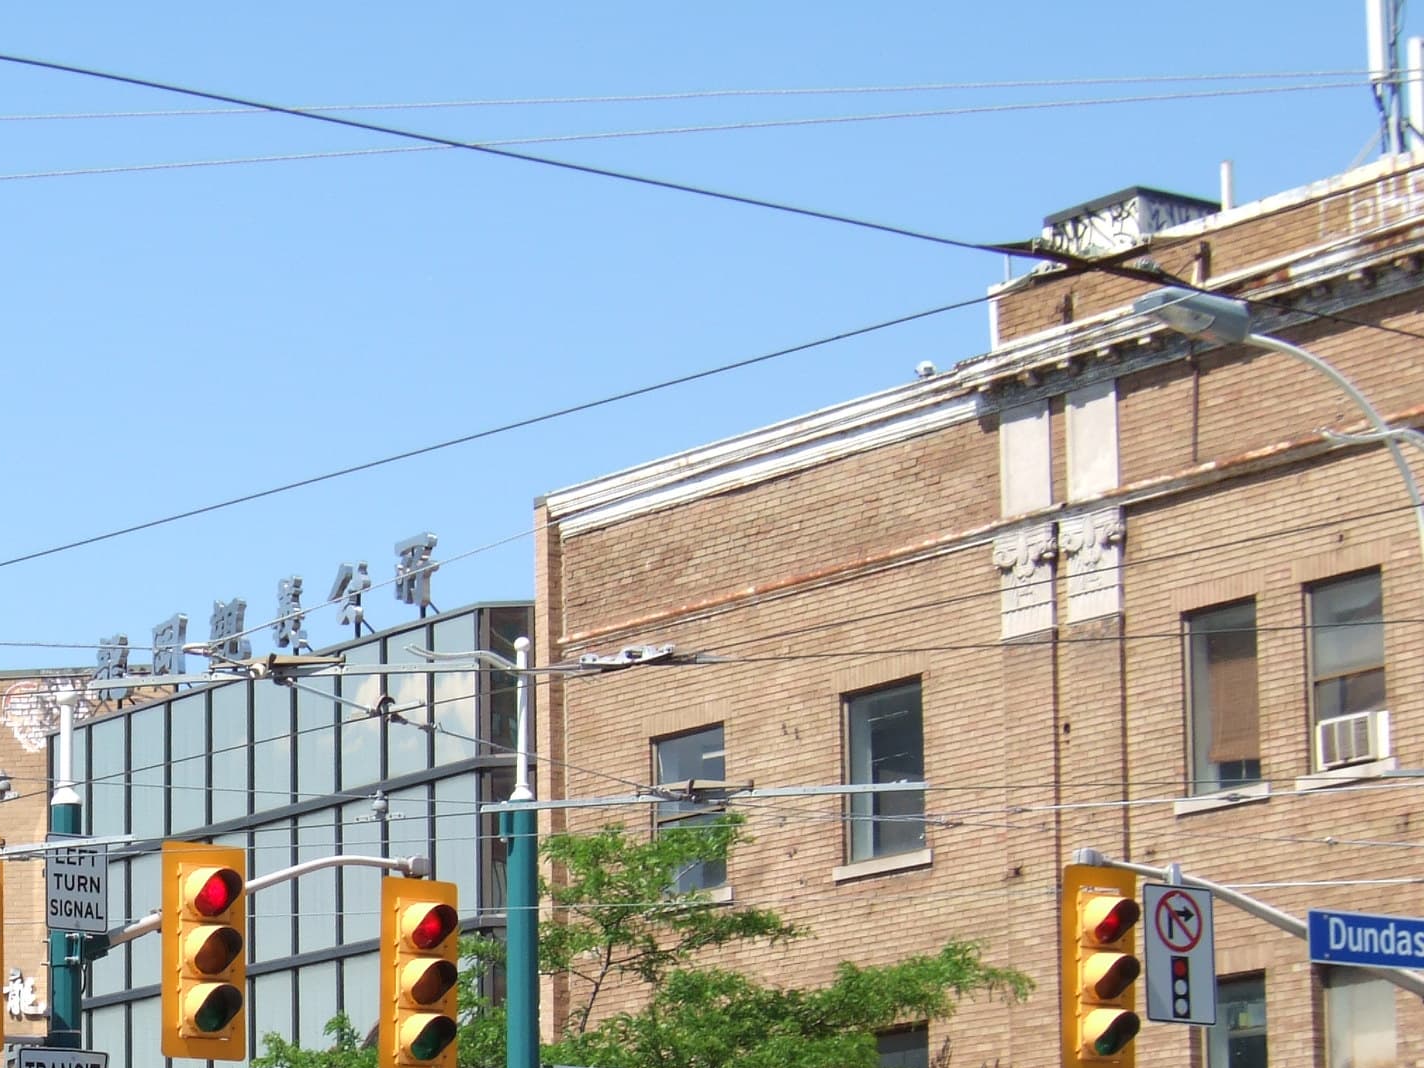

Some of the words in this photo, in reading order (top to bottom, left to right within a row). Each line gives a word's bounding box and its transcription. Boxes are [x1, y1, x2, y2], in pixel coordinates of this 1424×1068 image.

[55, 847, 98, 867] LEFT
[53, 873, 101, 893] TURN
[50, 899, 104, 920] SIGNAL
[1329, 917, 1424, 958] Dundas
